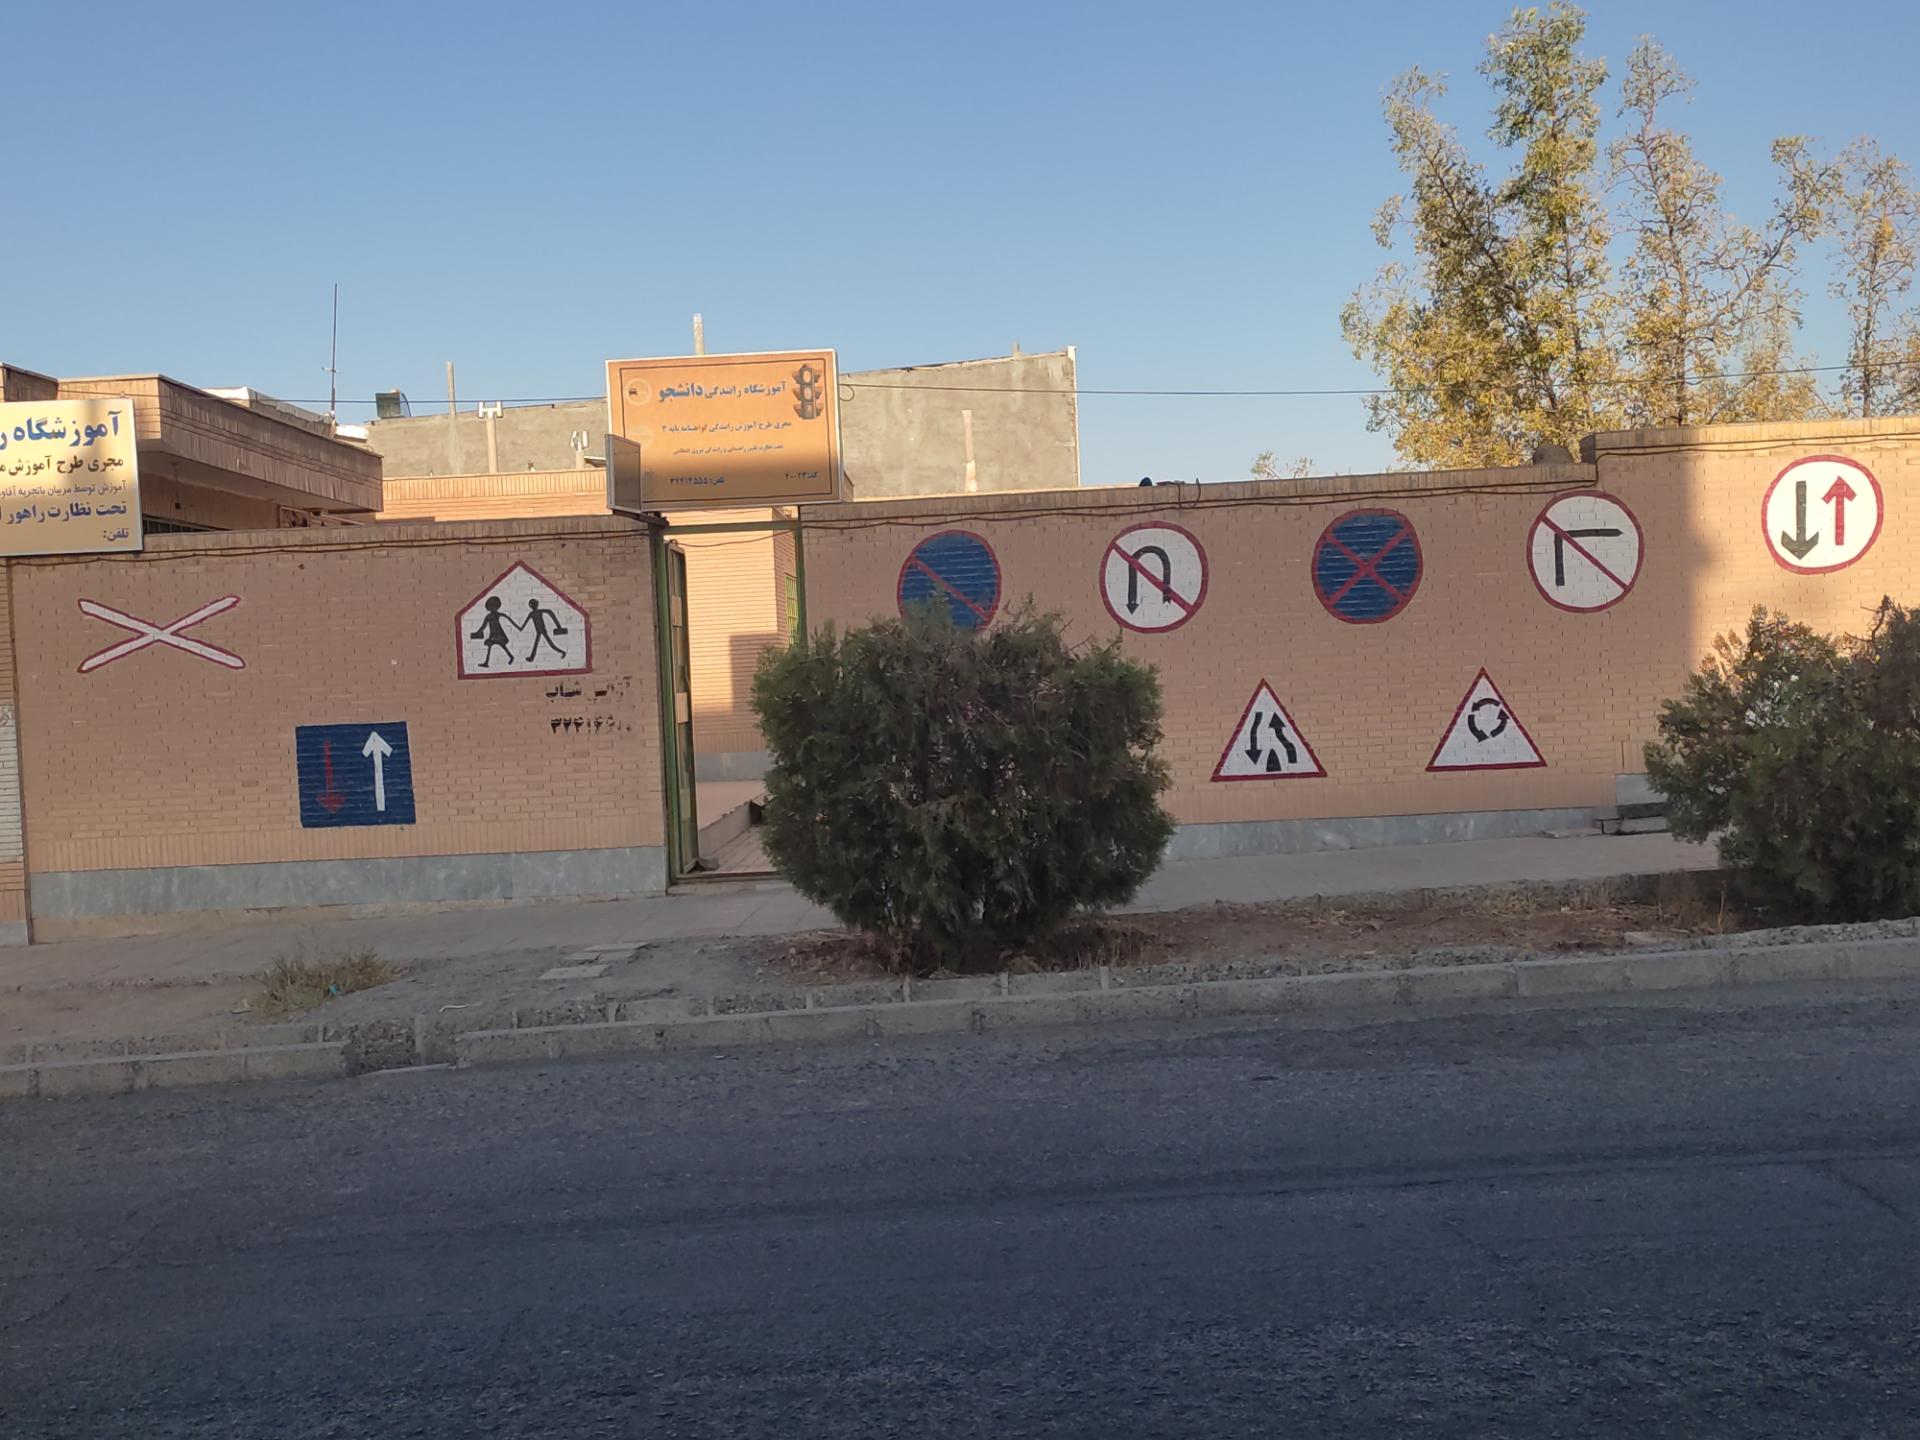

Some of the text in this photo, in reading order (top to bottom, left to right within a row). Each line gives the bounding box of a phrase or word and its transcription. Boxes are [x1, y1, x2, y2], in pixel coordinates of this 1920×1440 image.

[659, 383, 703, 403] دانشجو
[13, 410, 122, 447] آموزشگاه
[9, 455, 52, 476] آموزش
[56, 455, 84, 474] طرح
[88, 457, 124, 473] مجری
[48, 485, 72, 497] مربیان
[73, 483, 96, 496] توسط
[97, 480, 127, 495] آموزش
[7, 504, 46, 525] راهور
[47, 502, 92, 522] نظارت
[95, 501, 127, 516] تحت
